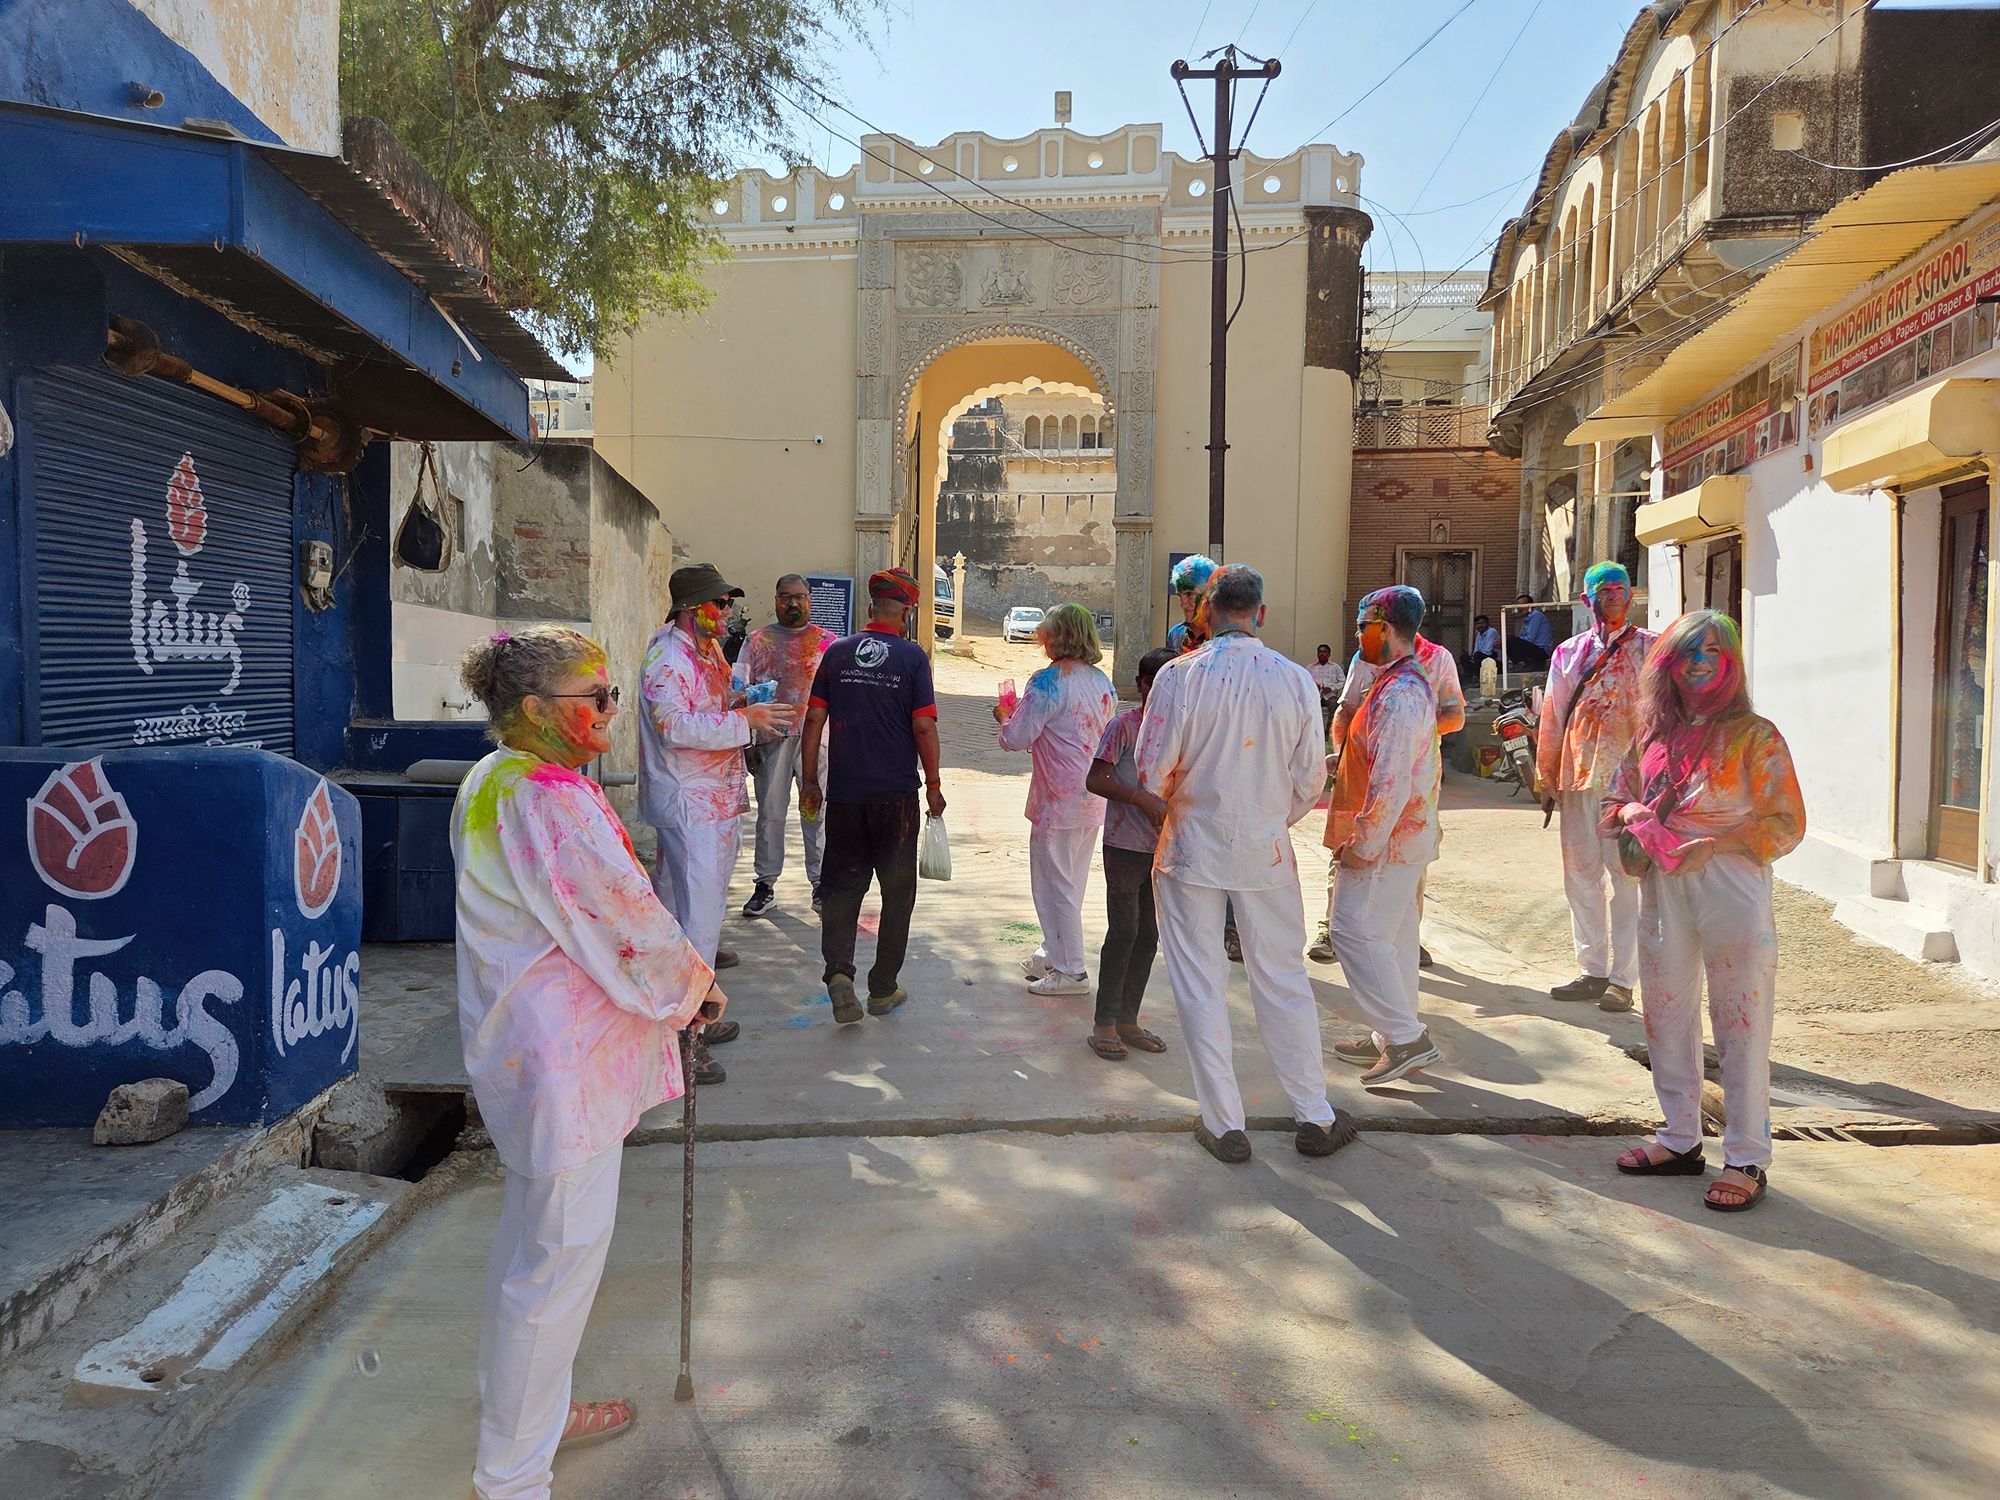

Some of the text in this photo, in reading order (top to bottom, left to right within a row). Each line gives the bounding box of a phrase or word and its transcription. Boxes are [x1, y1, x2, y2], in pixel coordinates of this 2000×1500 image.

[1810, 366, 1841, 389] Miniature,
[1842, 347, 1868, 370] Painting
[1868, 341, 1879, 355] on
[1879, 331, 1894, 351] Silk,
[1895, 319, 1920, 340] Paper,
[1921, 309, 1936, 326] Old
[1937, 294, 1963, 317] Paper
[1964, 286, 1973, 302] &
[1823, 238, 1971, 361] MANDAWA ART SCHOOL
[1673, 407, 1704, 449] MARUTI
[1705, 391, 1731, 430] GEMS
[876, 672, 901, 682] SARI
